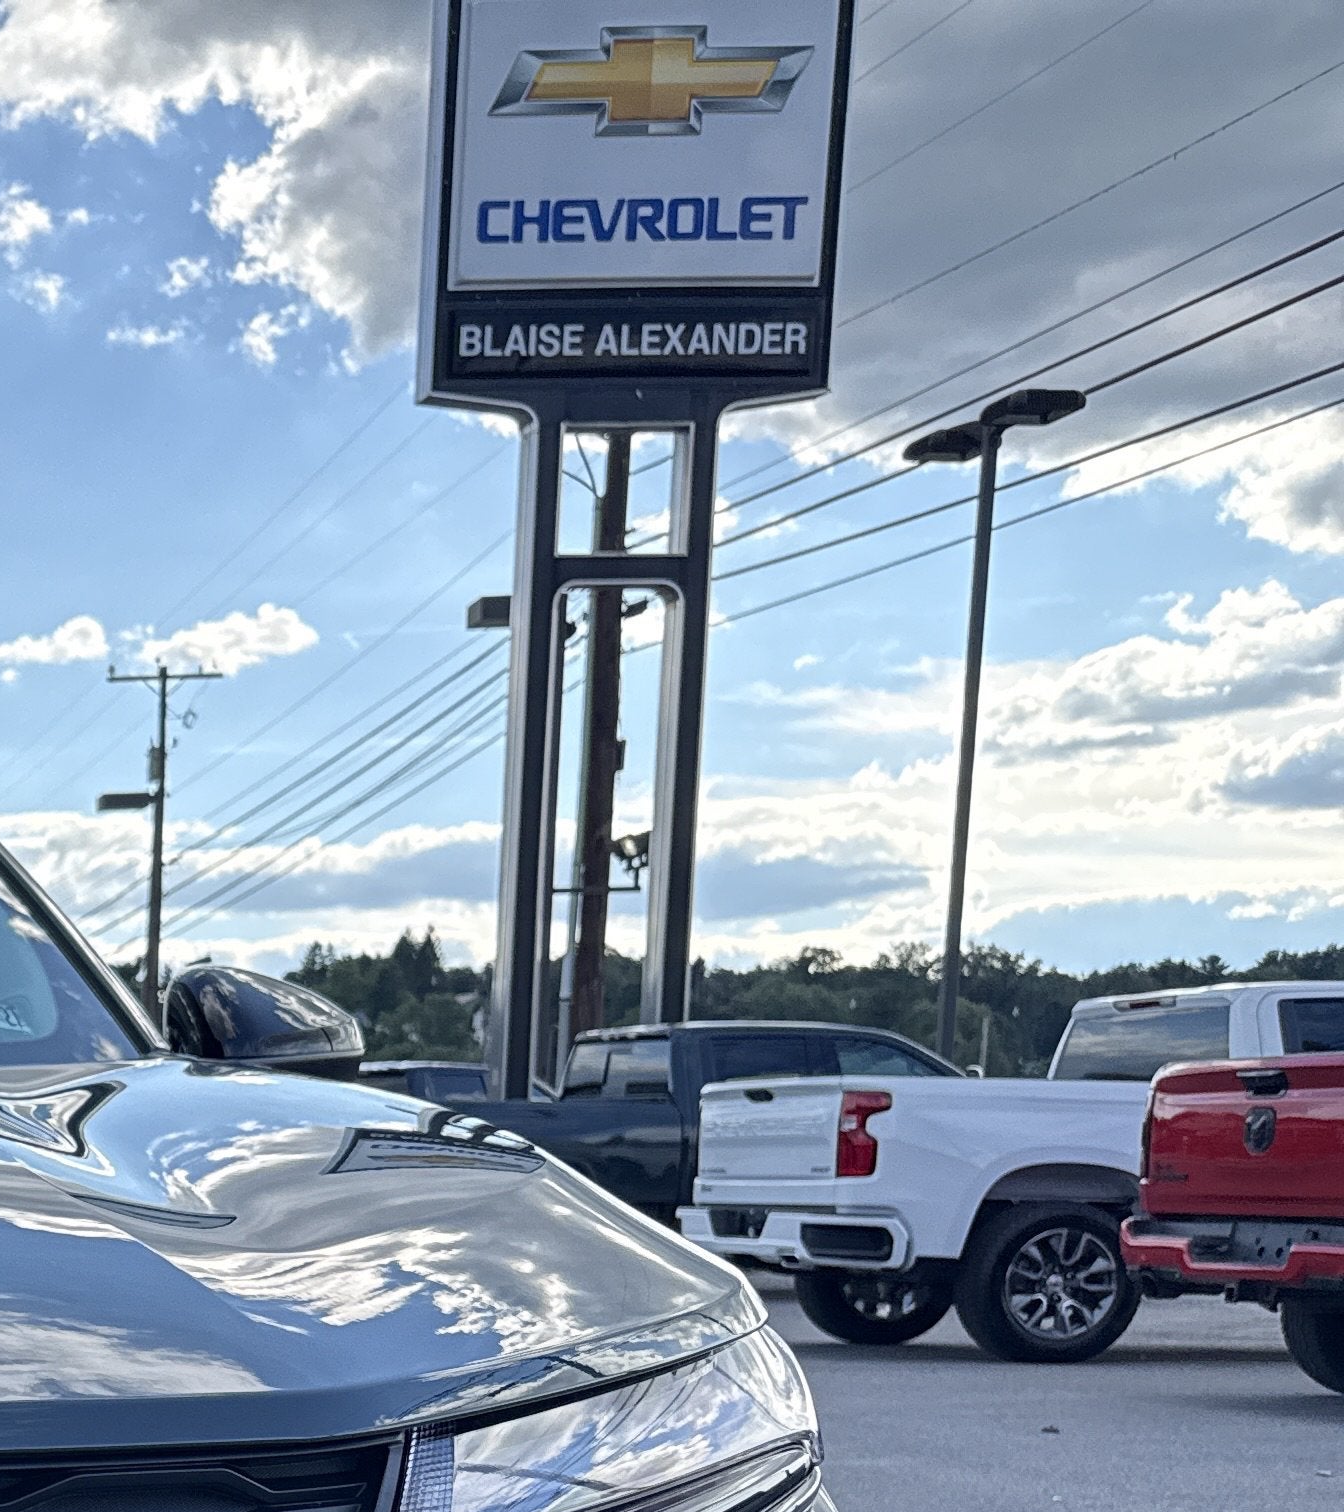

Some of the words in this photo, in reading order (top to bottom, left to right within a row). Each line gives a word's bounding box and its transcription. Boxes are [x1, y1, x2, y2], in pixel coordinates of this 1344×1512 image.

[476, 196, 808, 244] CHEVROLET
[458, 323, 585, 358] BLAISE
[594, 321, 808, 357] ALEXANDER
